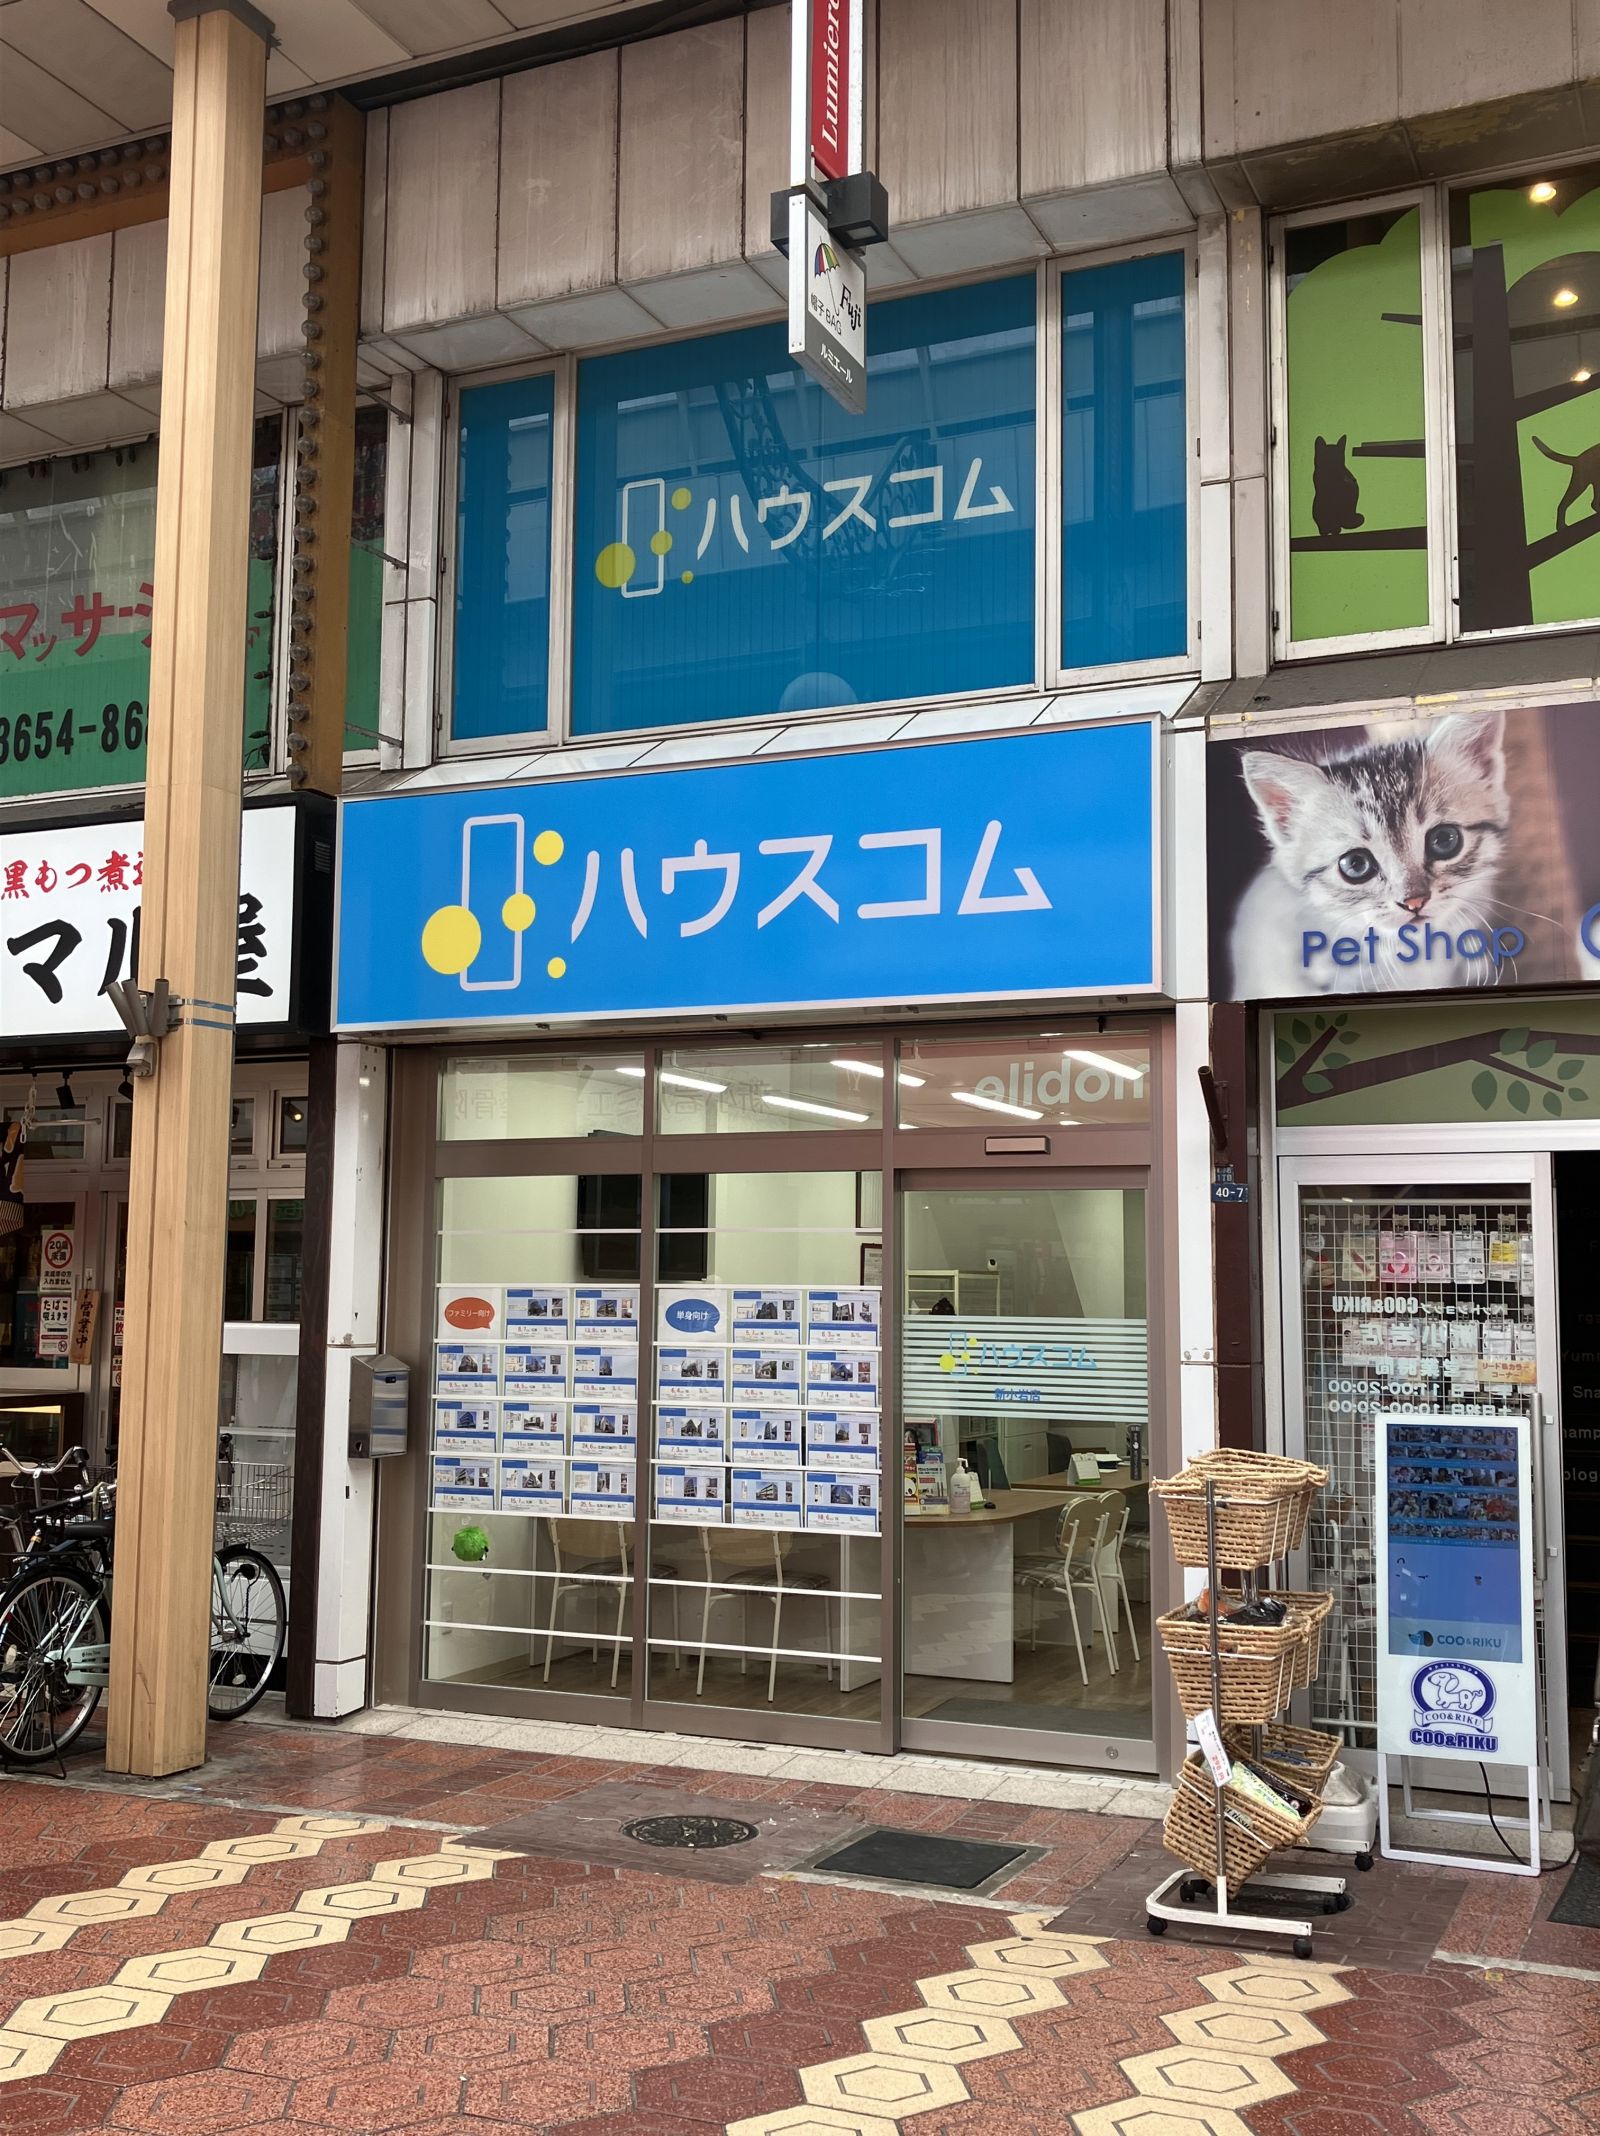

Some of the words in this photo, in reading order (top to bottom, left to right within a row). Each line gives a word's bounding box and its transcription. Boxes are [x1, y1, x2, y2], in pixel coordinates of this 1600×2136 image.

[839, 282, 862, 331] Fuji
[825, 308, 842, 336] BAG
[820, 343, 853, 384] ルミエール
[696, 456, 1016, 561] ハウスコム
[570, 818, 1054, 945] ハウスコム
[1302, 926, 1380, 968] Pet
[1396, 922, 1525, 967] Shop
[1215, 1187, 1244, 1198] 40-7
[42, 1300, 69, 1311] たばこ
[42, 1312, 69, 1321] 吸えます
[447, 1309, 491, 1318] ファミリー向け
[676, 1310, 709, 1321] 単身向け
[75, 1301, 94, 1349] 営業中
[979, 1343, 1099, 1370] ハウスコム
[994, 1388, 1041, 1403] 新小岩店
[1425, 1712, 1482, 1727] COO&RIKU
[1410, 1728, 1498, 1752] COO&RIKU
